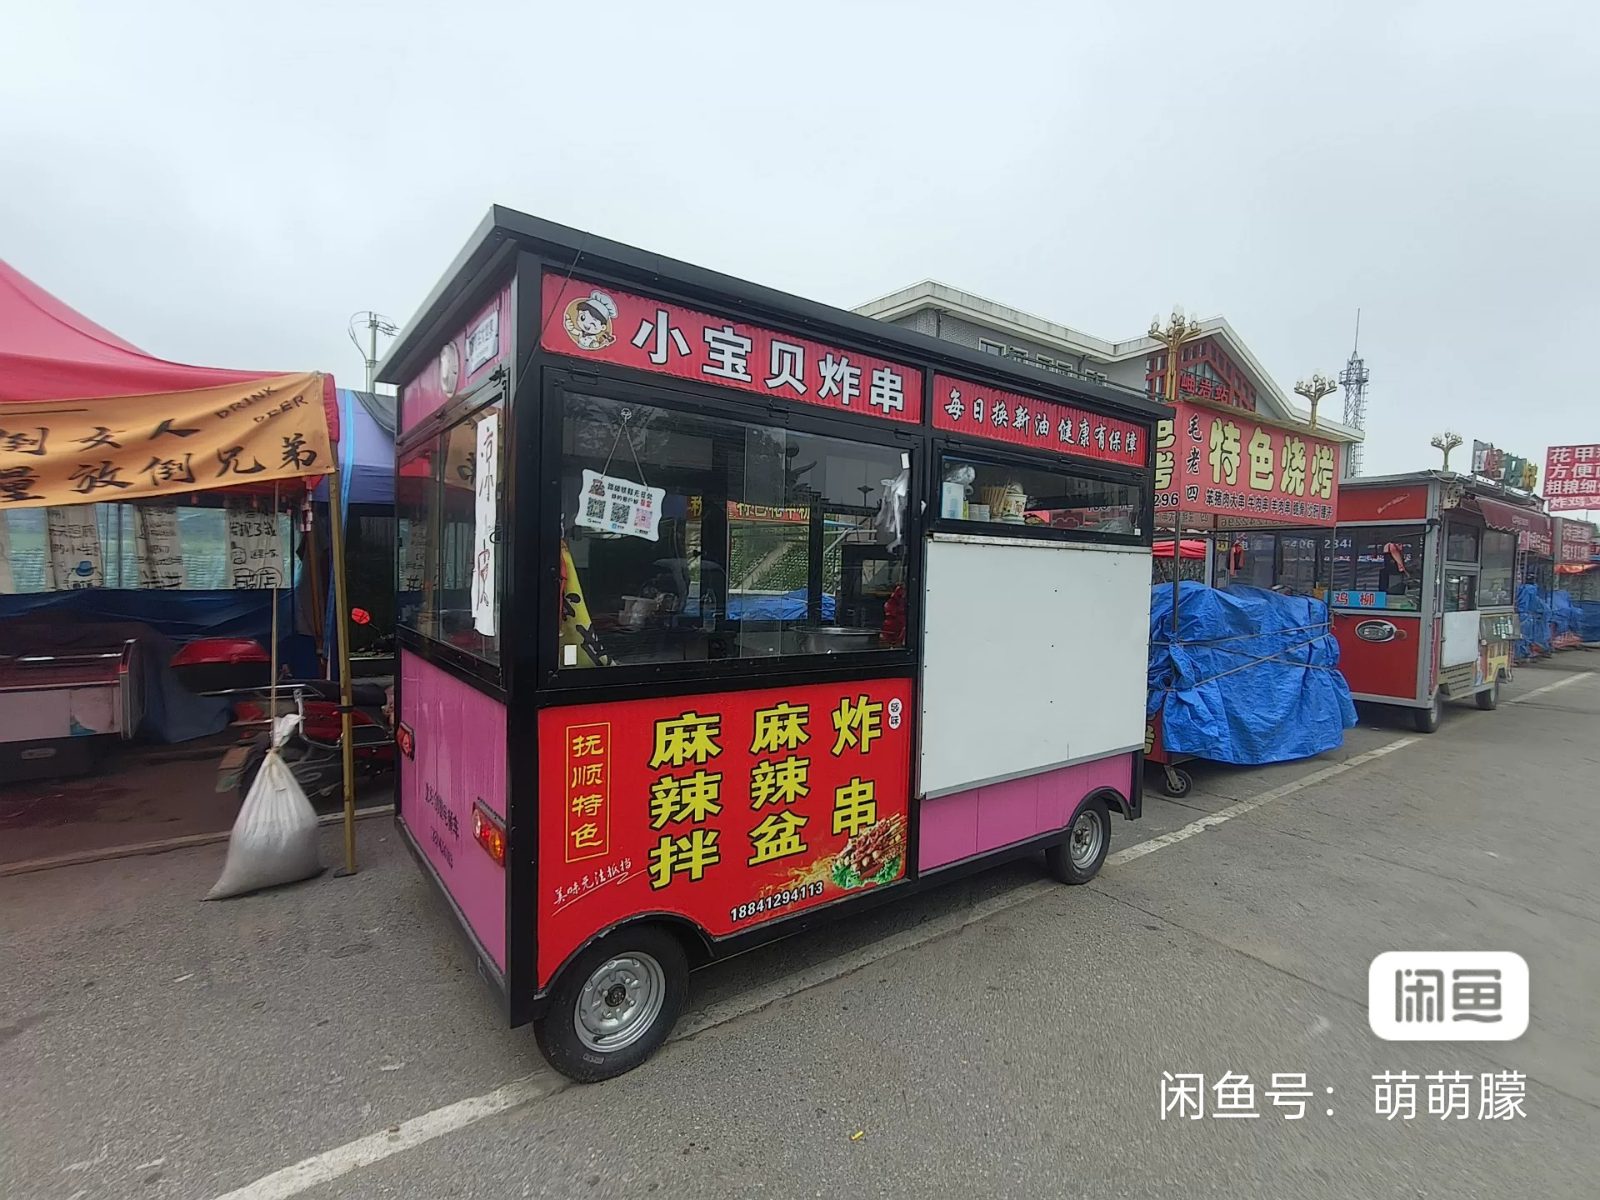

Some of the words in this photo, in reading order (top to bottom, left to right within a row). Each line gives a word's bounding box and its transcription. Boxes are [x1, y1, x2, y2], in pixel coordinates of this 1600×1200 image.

[217, 386, 278, 419] DRINK
[632, 310, 904, 414] 小宝贝炸串
[944, 388, 1051, 437] 每日换新油
[1058, 418, 1138, 458] 健康有保障
[1186, 413, 1204, 504] 毛老四
[1208, 417, 1335, 500] 特色烧烤
[1549, 446, 1600, 463] 花甲
[1545, 479, 1600, 495] 粗粮细
[571, 734, 604, 849] 抚顺特色
[648, 710, 722, 891] 麻辣拌
[747, 702, 810, 868] 麻辣盆
[832, 695, 883, 837] 炸串
[729, 880, 825, 922] 18841294113
